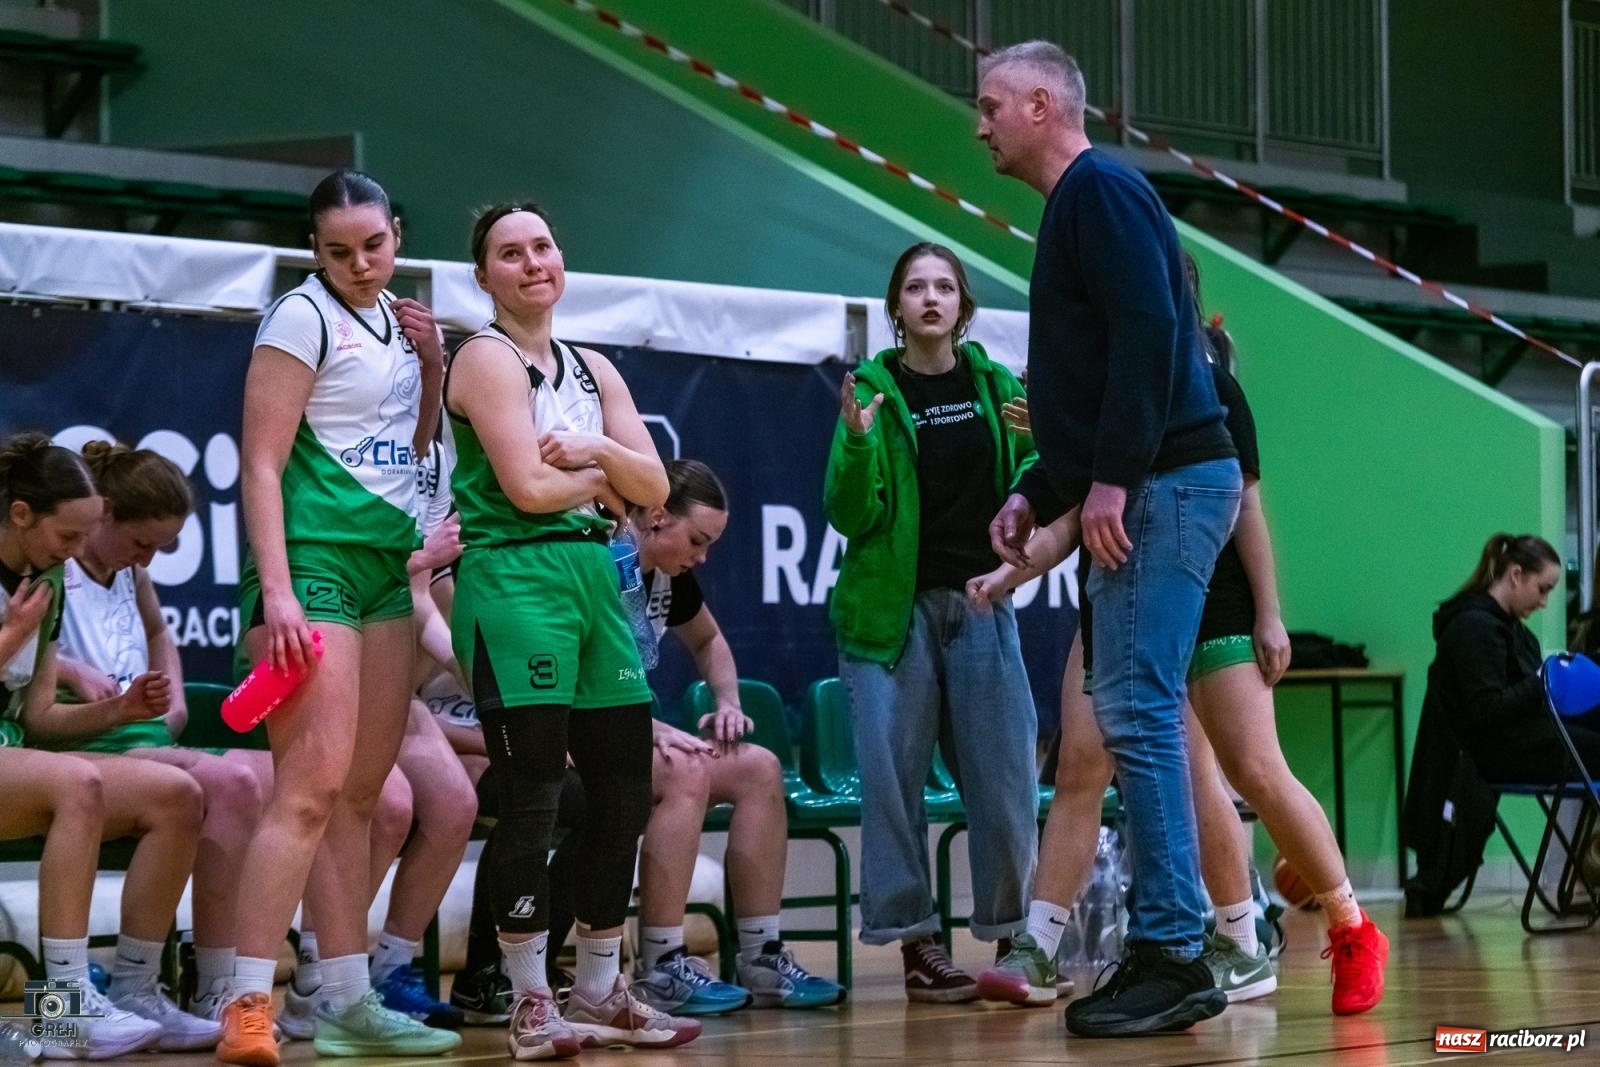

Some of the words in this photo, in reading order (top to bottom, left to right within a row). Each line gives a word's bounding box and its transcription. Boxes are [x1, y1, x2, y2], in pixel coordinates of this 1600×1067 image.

[934, 411, 974, 426] SPORTOWO
[941, 401, 972, 413] ZDROWO
[528, 653, 558, 689] 3
[228, 671, 256, 703] Tacx
